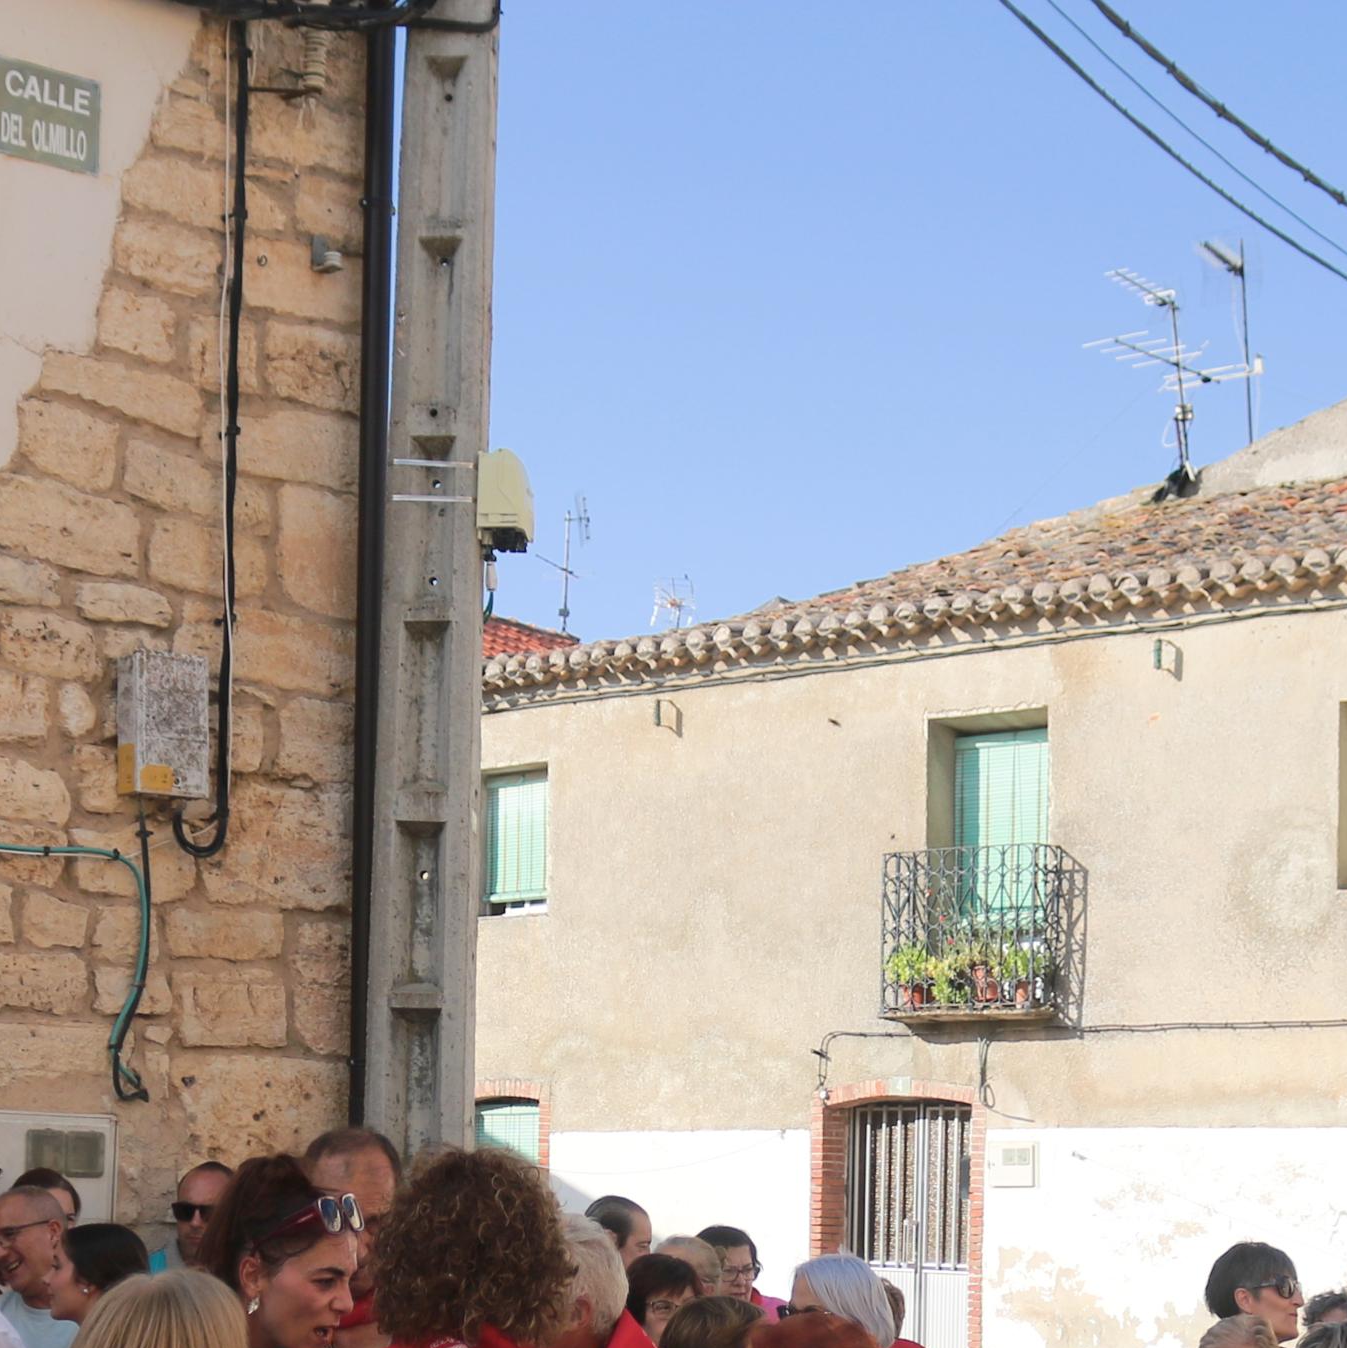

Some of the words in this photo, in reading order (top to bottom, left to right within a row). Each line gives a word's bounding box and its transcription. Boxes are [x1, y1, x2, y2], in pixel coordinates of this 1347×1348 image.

[5, 69, 91, 116] CALLE
[1, 111, 27, 148] DEL
[32, 119, 87, 161] OLMILLO
